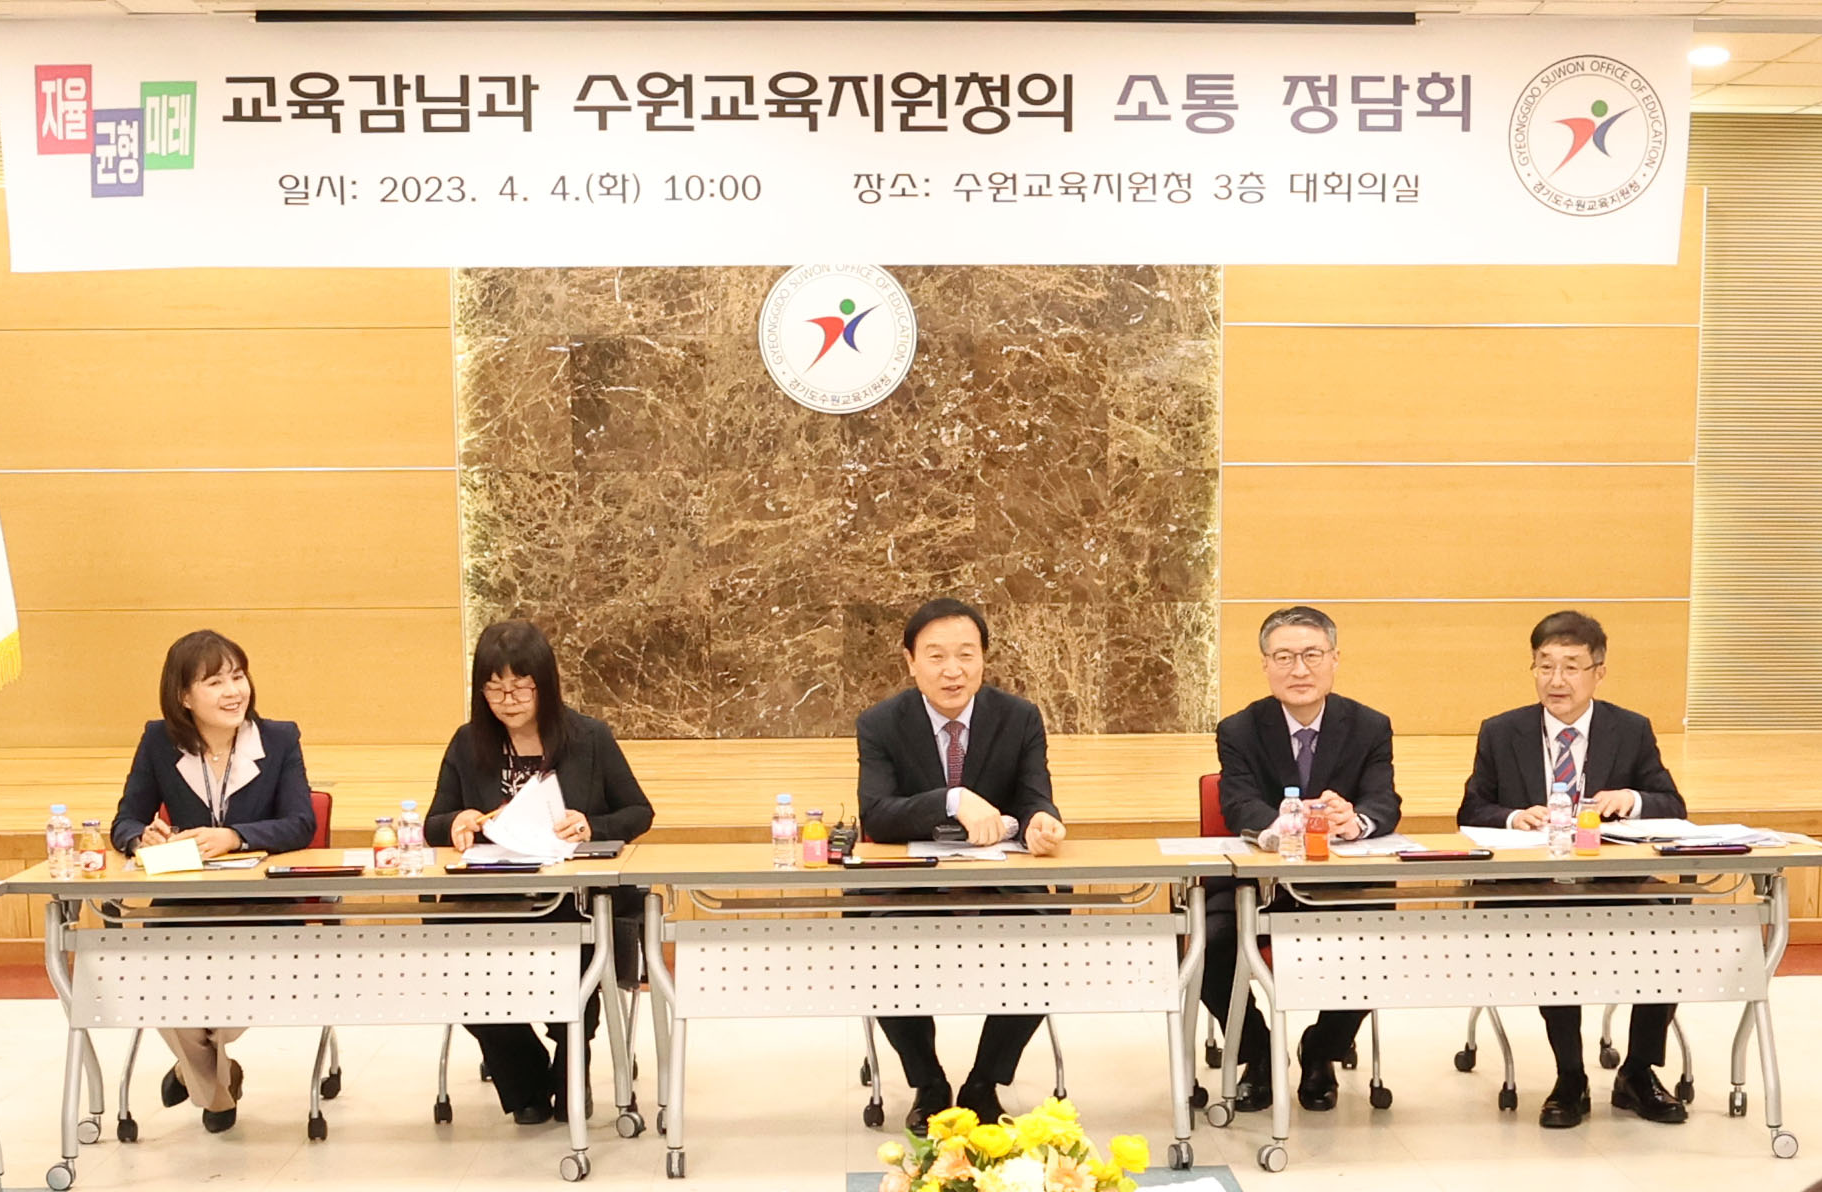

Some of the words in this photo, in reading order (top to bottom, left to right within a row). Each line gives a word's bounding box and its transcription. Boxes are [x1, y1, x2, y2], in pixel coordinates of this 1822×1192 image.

[41, 77, 87, 140] 자율
[145, 93, 191, 157] 미래
[222, 71, 540, 134] 교육감님과
[573, 70, 1074, 135] 수원교육지원청의
[1114, 73, 1239, 134] 소통
[1283, 71, 1472, 134] 정담회
[1514, 86, 1542, 167] GYEONGGIDO
[1540, 60, 1586, 89] SUWON
[1589, 59, 1630, 82] OFFICE
[1630, 78, 1647, 94] OF
[1641, 93, 1664, 170] EDUCATION
[95, 119, 139, 185] 균형
[278, 174, 358, 206] 일시:
[379, 175, 477, 203] 2023.
[498, 175, 528, 202] 4.
[550, 172, 641, 204] 4.(화)
[665, 174, 762, 201] 10:00
[853, 172, 930, 205] 장소:
[953, 171, 1192, 204] 수원교육지원청
[1213, 171, 1266, 204] 3층
[1289, 171, 1419, 203] 대회의실
[1532, 180, 1641, 212] 경기도수원교육지원청
